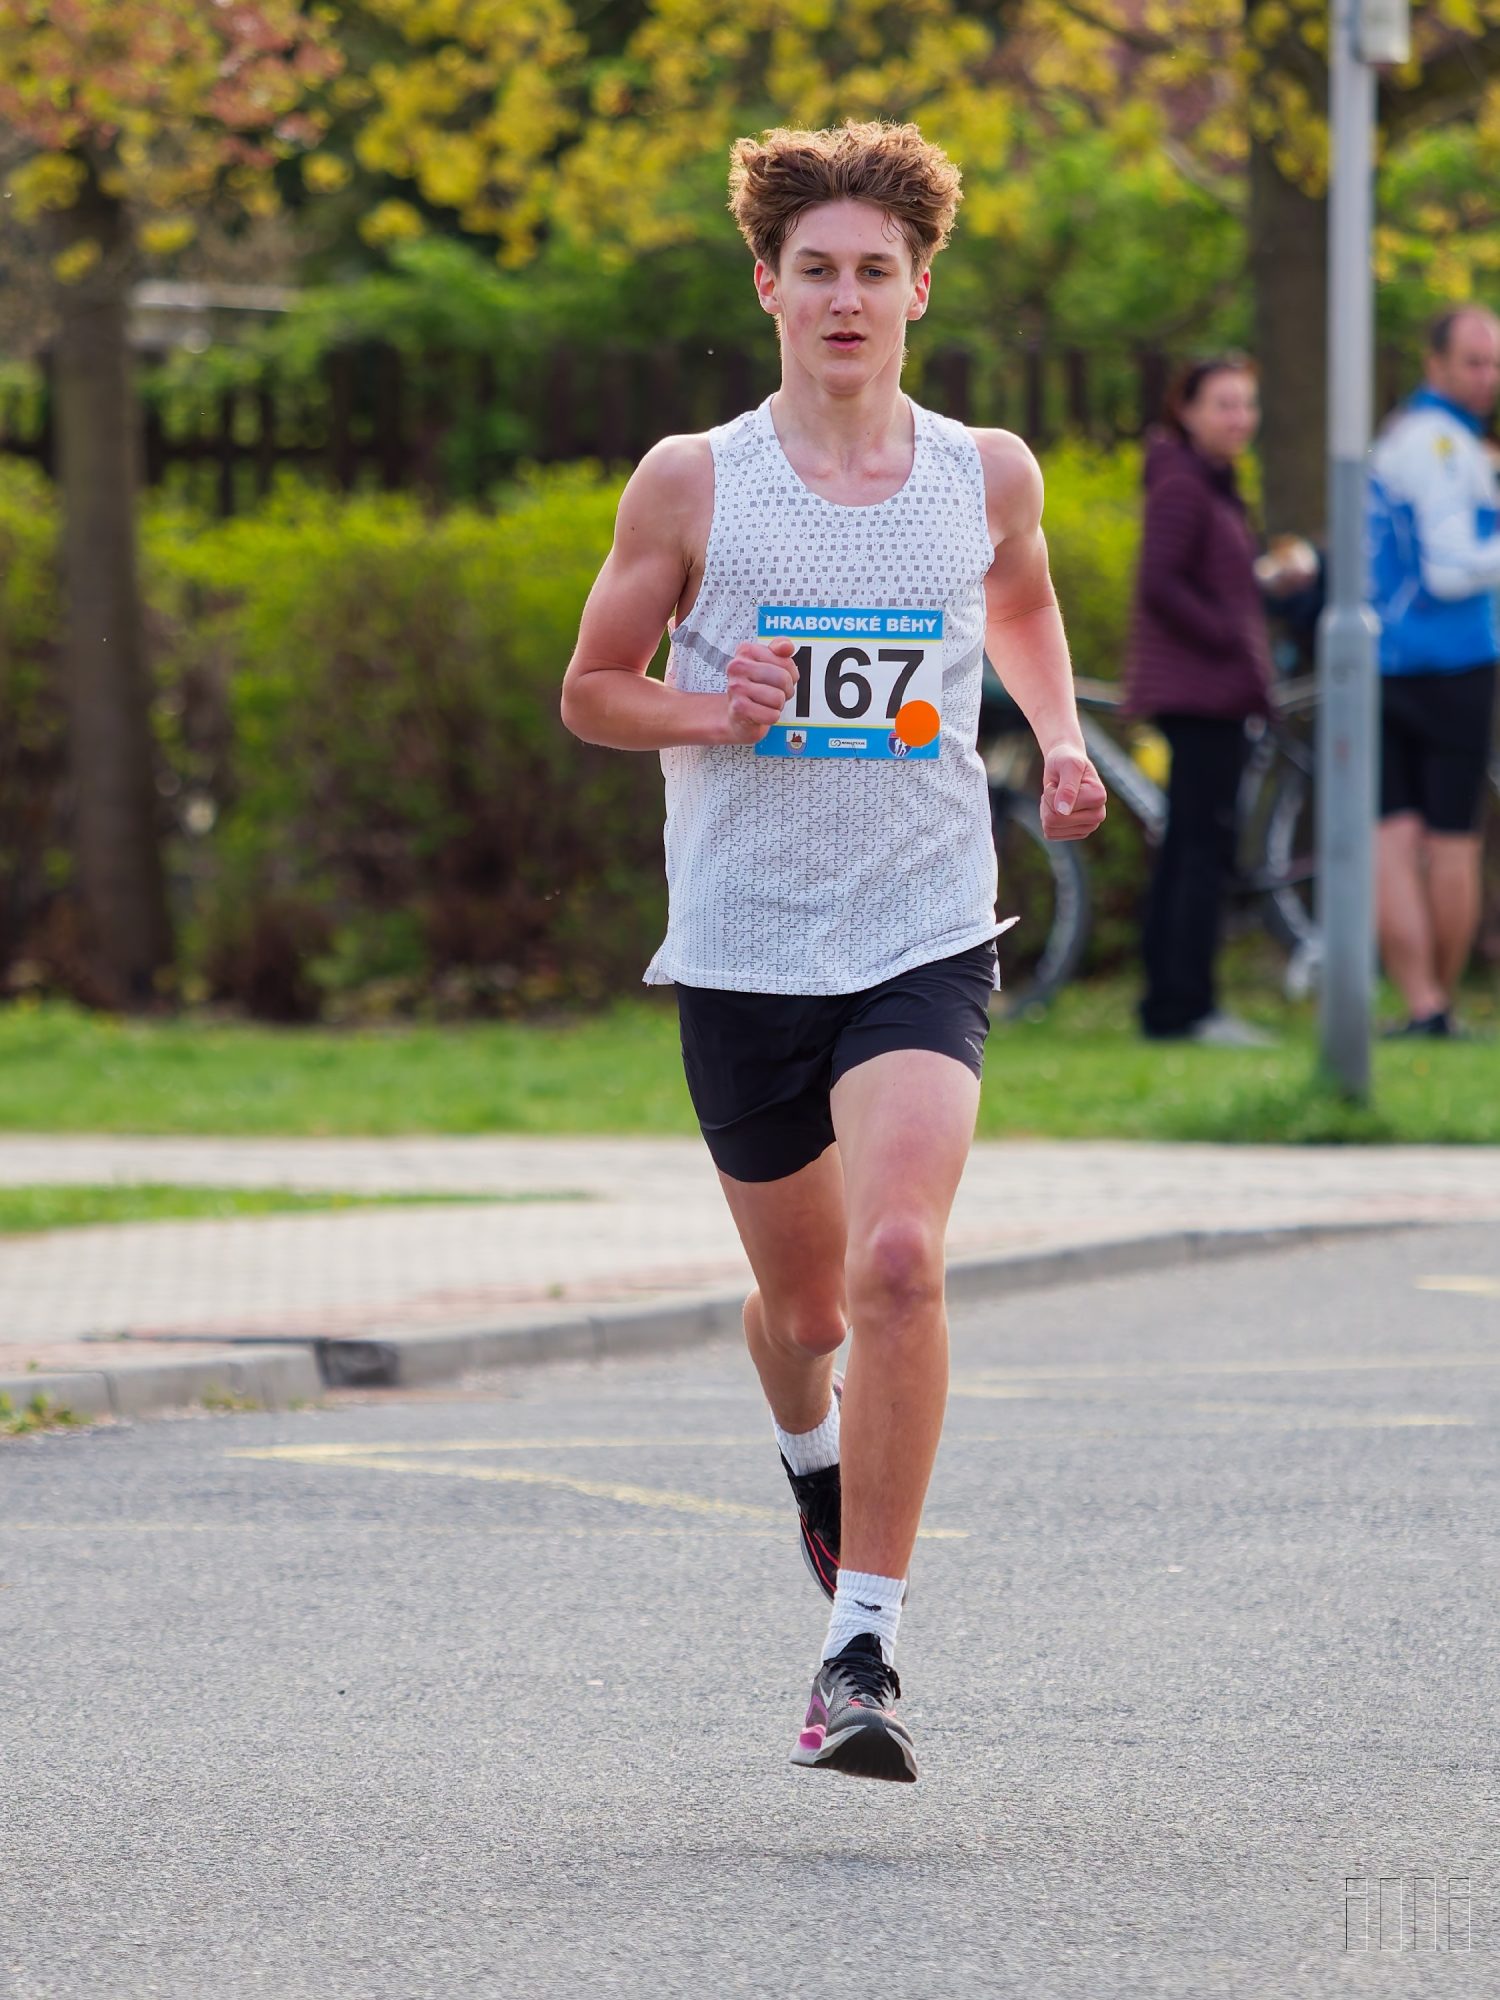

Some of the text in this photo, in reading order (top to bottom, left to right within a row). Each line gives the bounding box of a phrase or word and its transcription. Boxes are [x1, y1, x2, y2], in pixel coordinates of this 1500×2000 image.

[765, 615, 937, 633] HRABOVSKÉ BĚHY
[792, 646, 925, 720] 167
